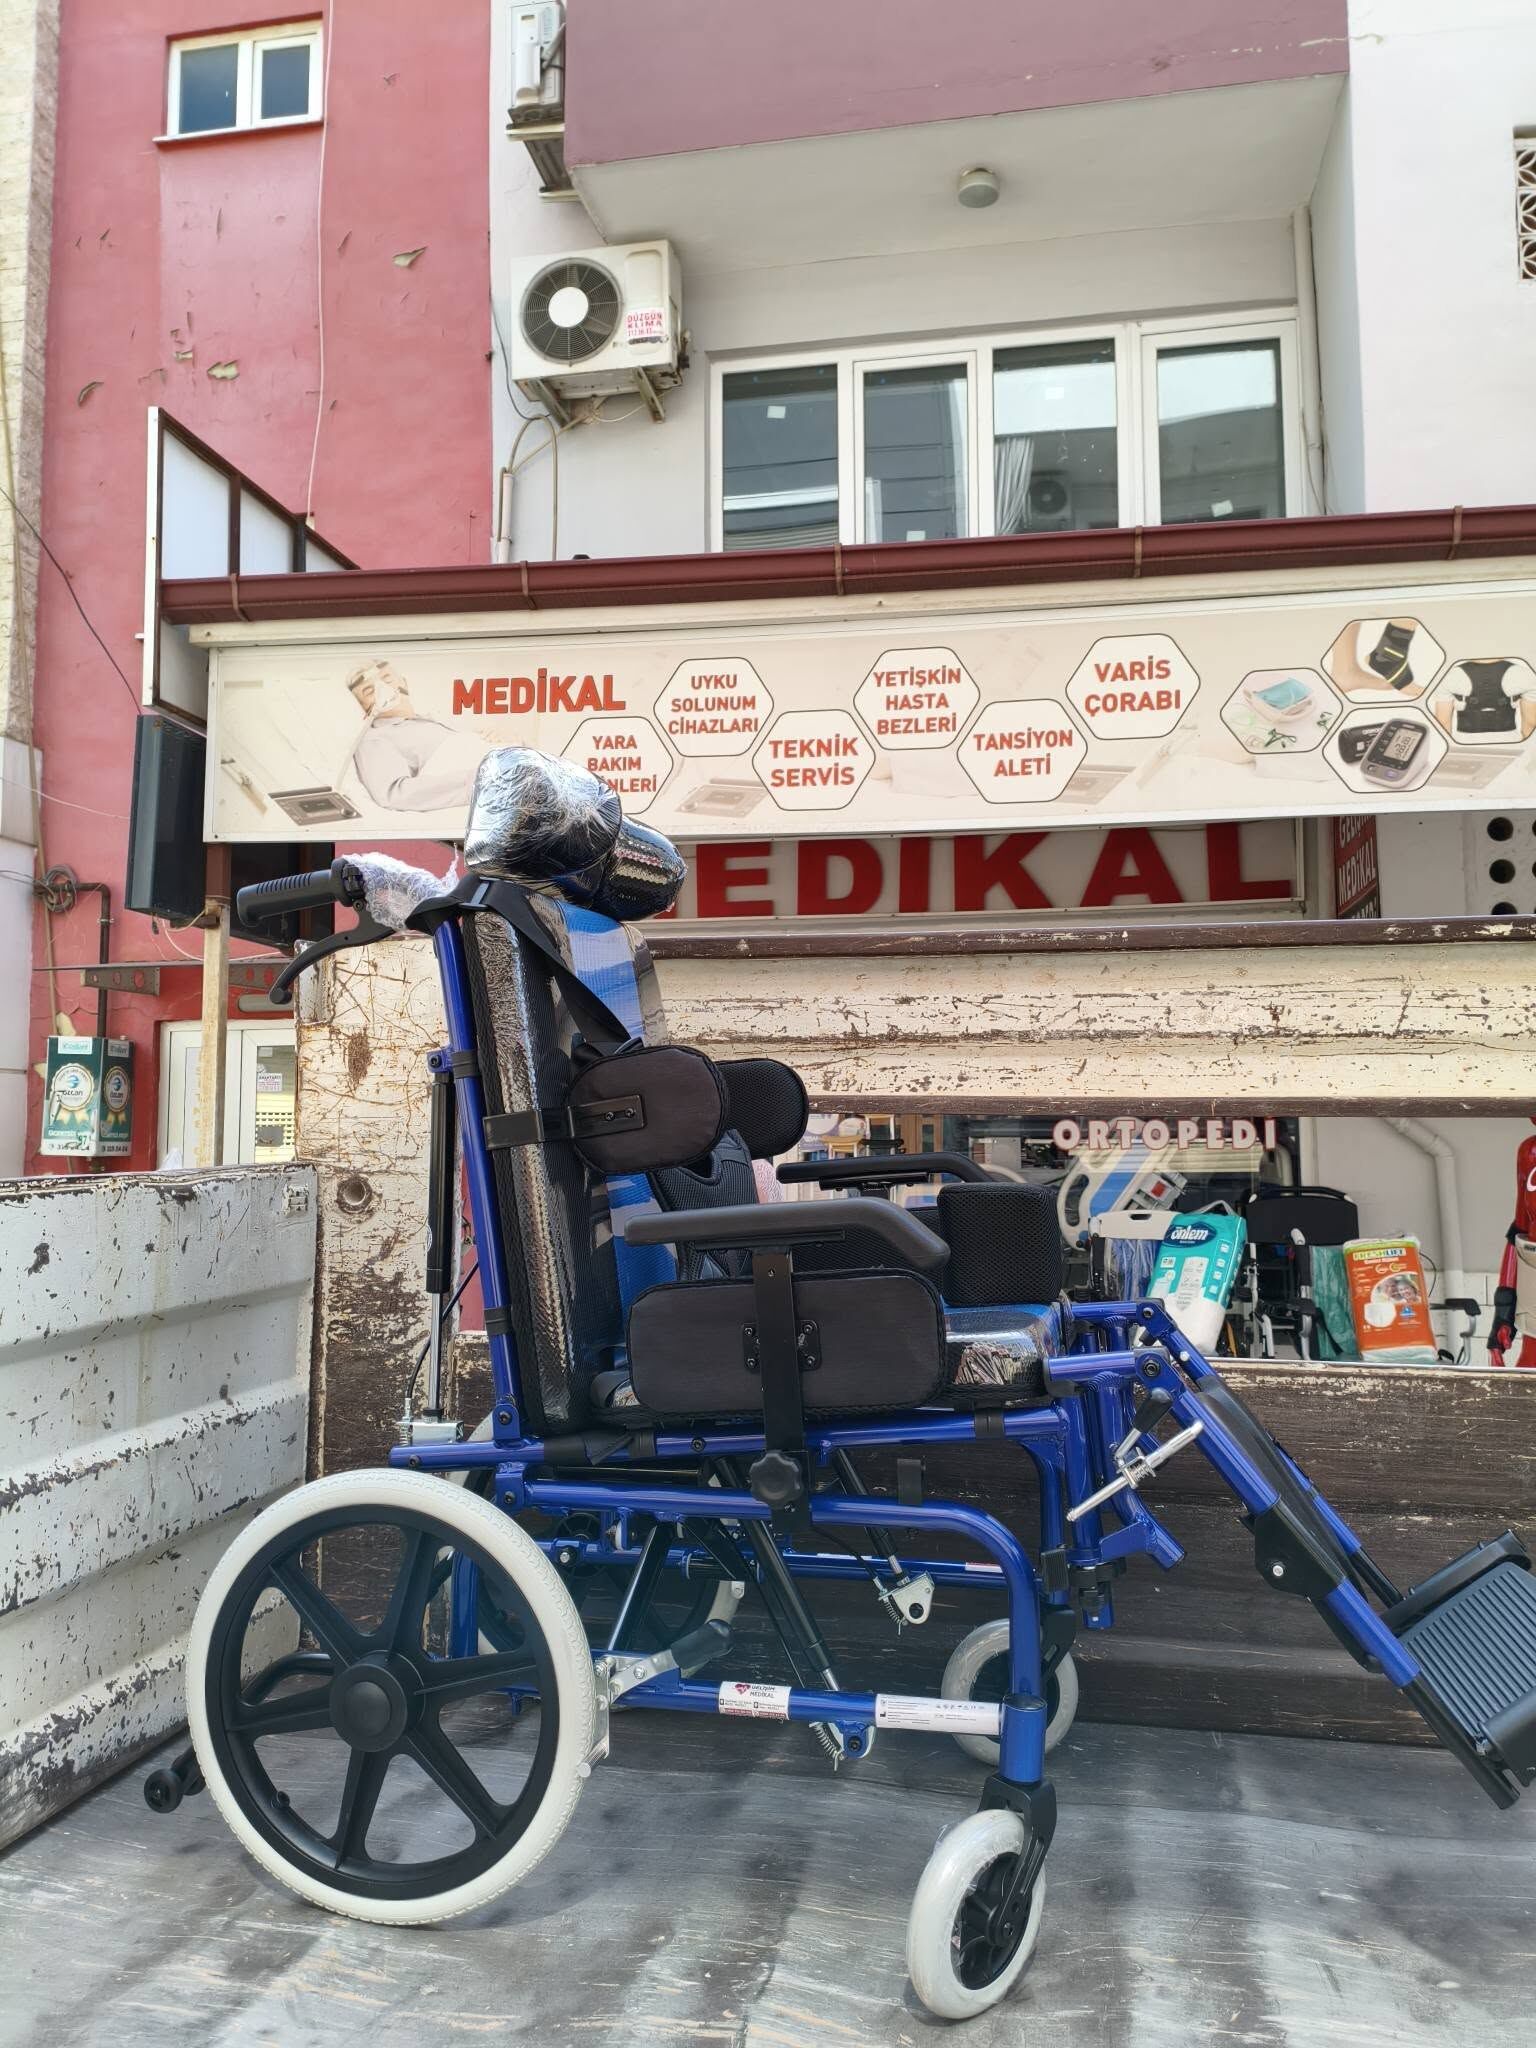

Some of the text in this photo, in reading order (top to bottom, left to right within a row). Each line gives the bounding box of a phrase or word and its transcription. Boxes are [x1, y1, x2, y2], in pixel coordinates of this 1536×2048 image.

[691, 673, 738, 690] UYKU
[873, 664, 961, 689] YETİŞKİN
[1094, 656, 1171, 683] VARİS
[452, 668, 626, 715] MEDİKAL
[885, 691, 949, 711] HASTA
[1084, 689, 1181, 717] ÇORABI
[671, 696, 756, 713] SOLUNUM
[668, 717, 759, 735] CİHAZLARI
[876, 712, 957, 736] BEZLERİ
[592, 735, 638, 750] YARA
[769, 733, 859, 760] TEKNİK
[974, 727, 1073, 752] TANSİYON
[587, 756, 641, 772] BAKIM
[770, 762, 855, 789] SERVİS
[993, 752, 1051, 778] ALETİ
[657, 822, 1292, 919] EDIKAL
